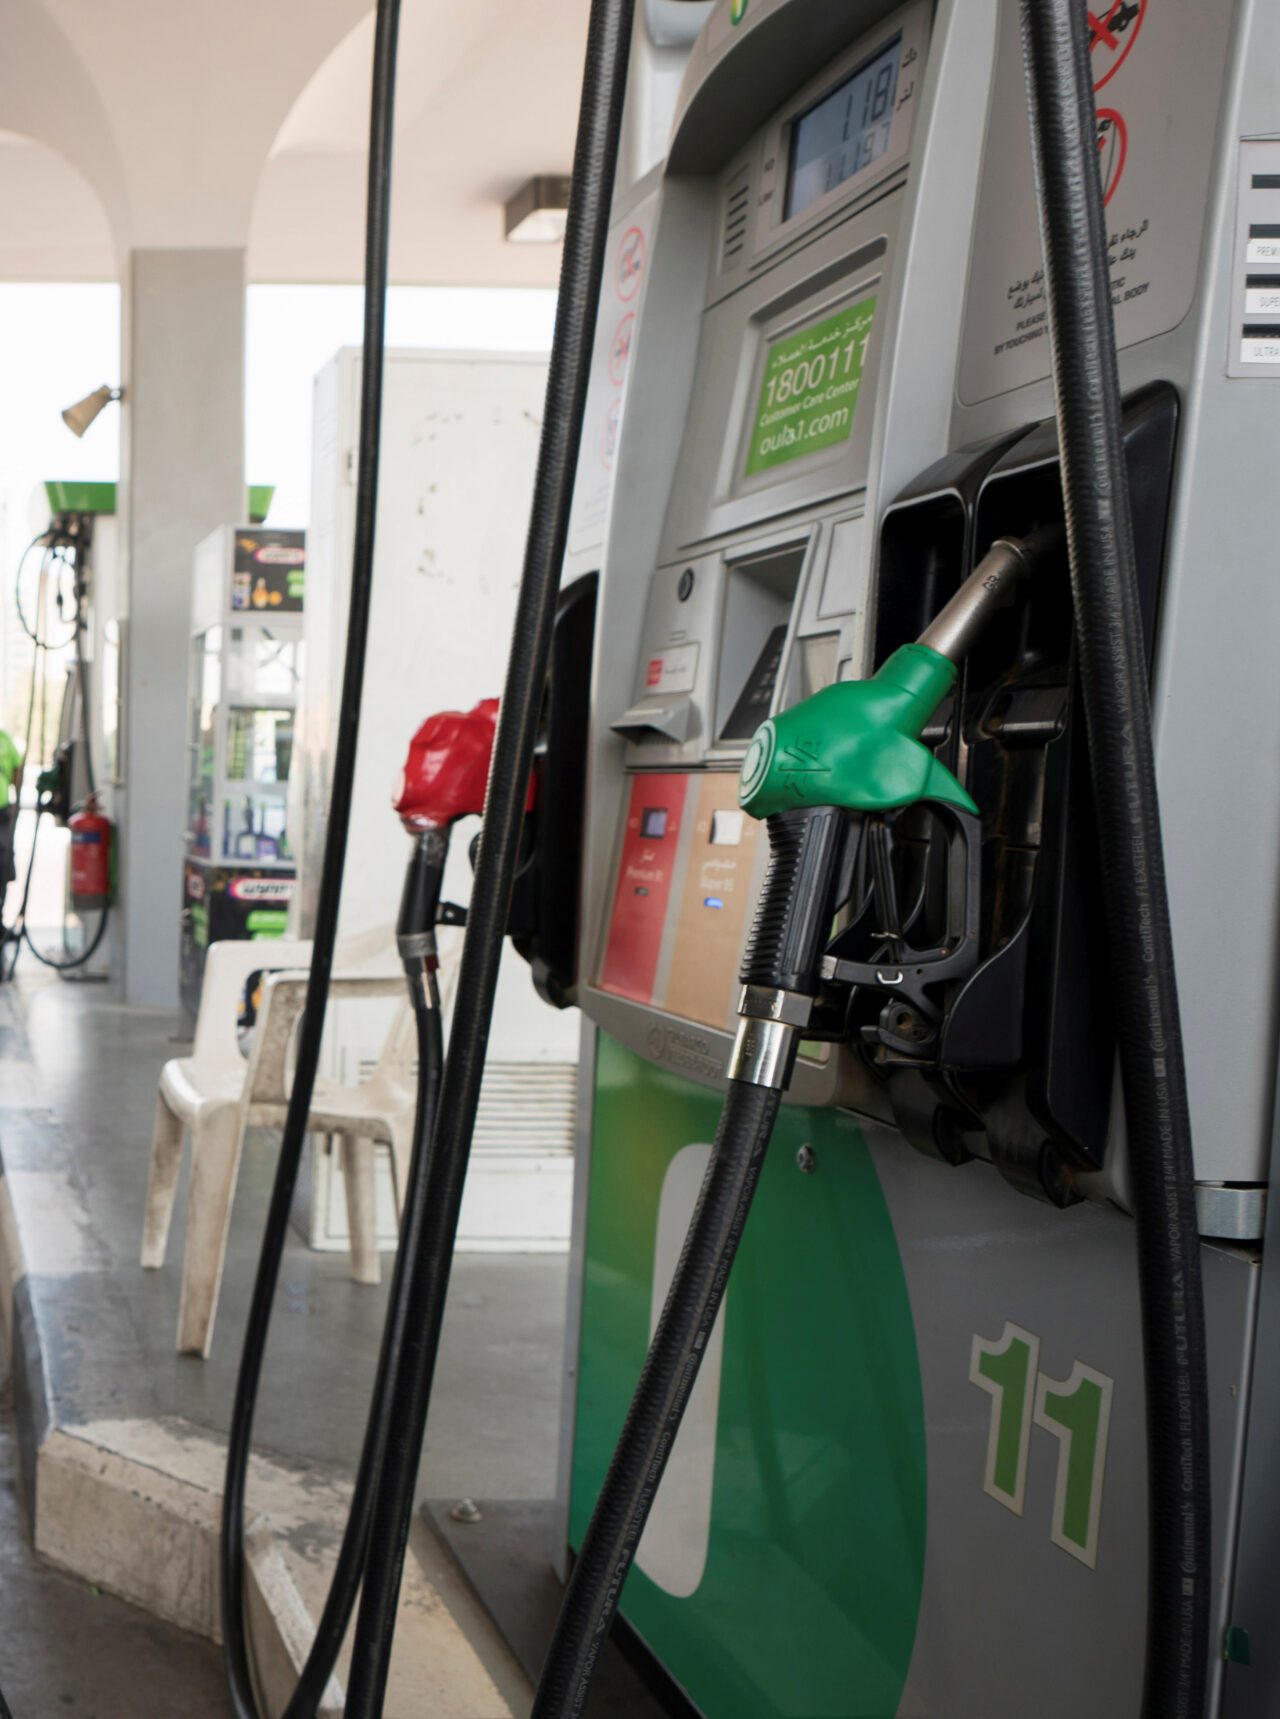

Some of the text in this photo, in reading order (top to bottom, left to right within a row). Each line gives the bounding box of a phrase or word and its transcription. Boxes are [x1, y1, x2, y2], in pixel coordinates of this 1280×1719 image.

[1016, 311, 1046, 331] PLEASE
[766, 331, 871, 408] 1800111
[759, 377, 860, 428] Customer Care Center
[759, 407, 849, 456] oula1.com
[1099, 524, 1115, 549] USA
[1101, 551, 1116, 566] IN
[1103, 568, 1120, 603] MADE
[1109, 631, 1125, 668] ASSIST
[1114, 672, 1130, 713] VAPOR
[1121, 720, 1143, 823] FUTURA
[1131, 833, 1147, 896] FLEXSTEEL
[1139, 904, 1155, 961] ContiTech
[1155, 1082, 1170, 1106] USA
[1157, 1108, 1170, 1122] IN
[1160, 1124, 1174, 1158] MADE
[1165, 1185, 1179, 1218] ASSIST
[1169, 1223, 1182, 1262] VAPOR
[713, 1259, 729, 1289] MADE
[1172, 1269, 1189, 1366] FUTURA
[1178, 1372, 1193, 1431] FLEXSTEEL
[968, 1321, 1115, 1571] 11
[1180, 1438, 1194, 1491] ContiTech
[596, 1549, 630, 1634] FUTURA
[1180, 1623, 1193, 1635] IN
[1182, 1601, 1194, 1621] USA
[582, 1642, 600, 1676] VAPOR
[1180, 1639, 1193, 1668] MADE
[573, 1678, 589, 1707] ASSIST
